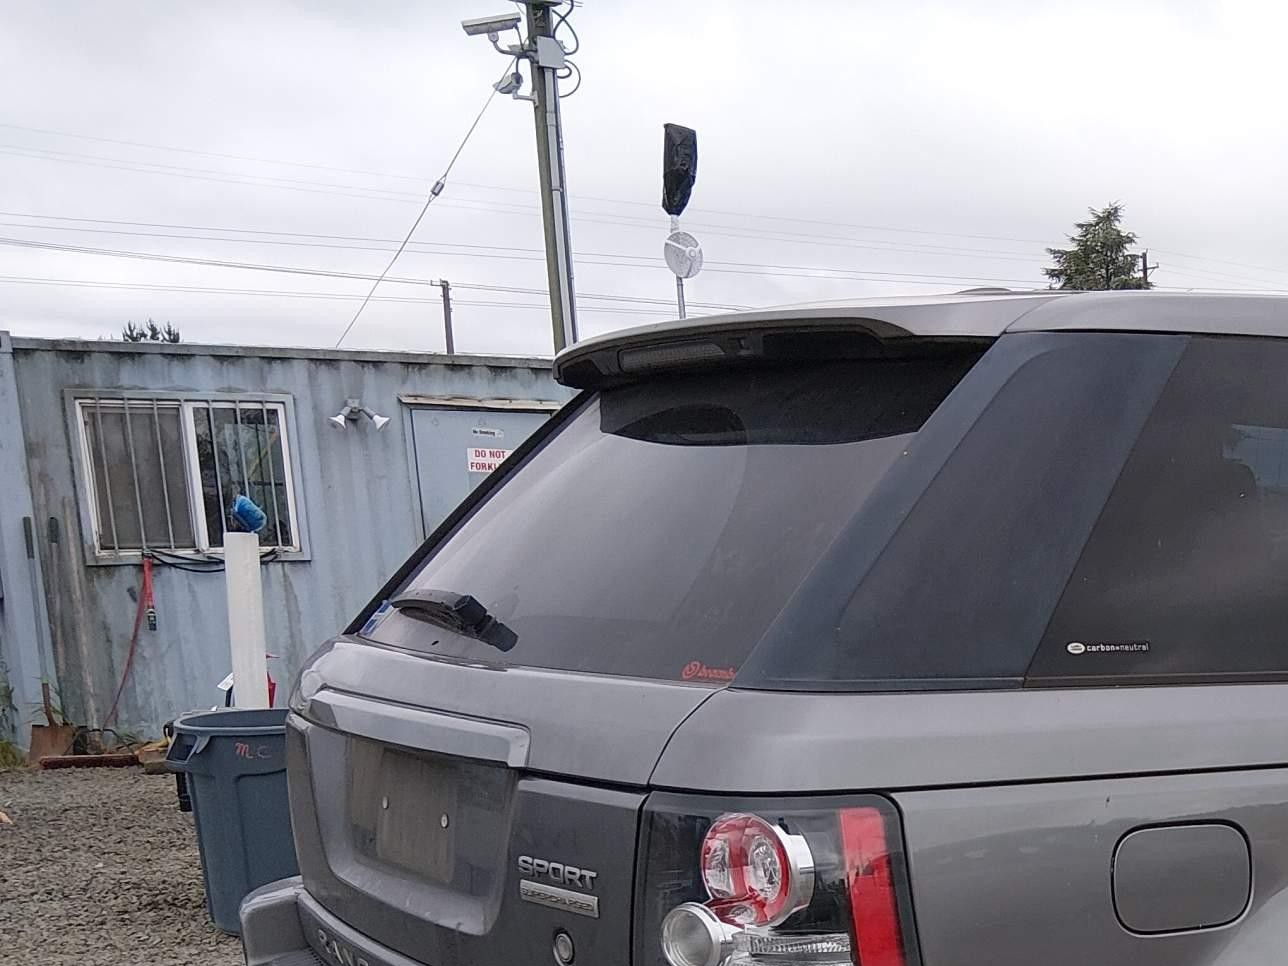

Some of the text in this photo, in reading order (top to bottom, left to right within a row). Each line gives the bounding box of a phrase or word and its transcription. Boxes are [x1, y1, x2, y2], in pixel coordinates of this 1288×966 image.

[474, 449, 506, 459] DO NOT
[518, 855, 598, 889] SPORT
